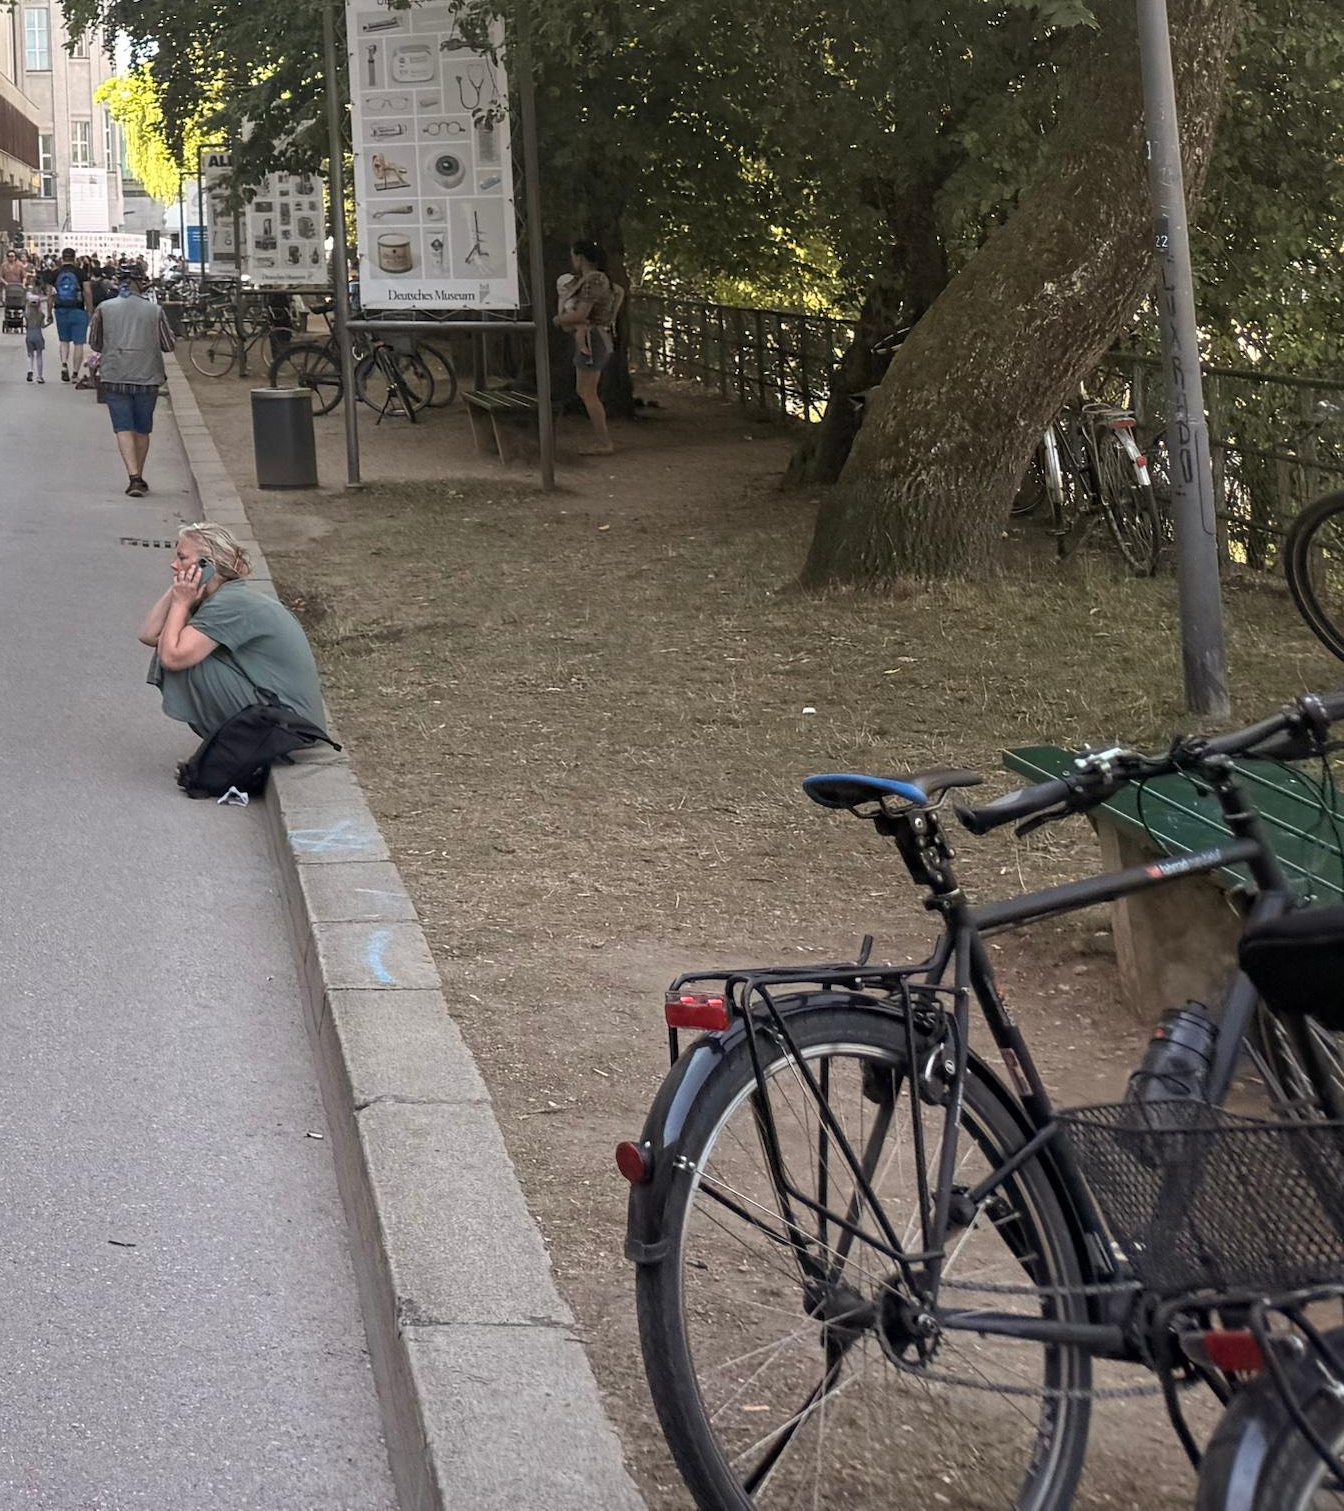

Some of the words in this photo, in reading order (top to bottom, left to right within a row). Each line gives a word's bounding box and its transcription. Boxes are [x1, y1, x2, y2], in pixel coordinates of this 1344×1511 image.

[1155, 234, 1168, 248] 22
[388, 288, 433, 301] Deutsches
[435, 289, 476, 301] Museum
